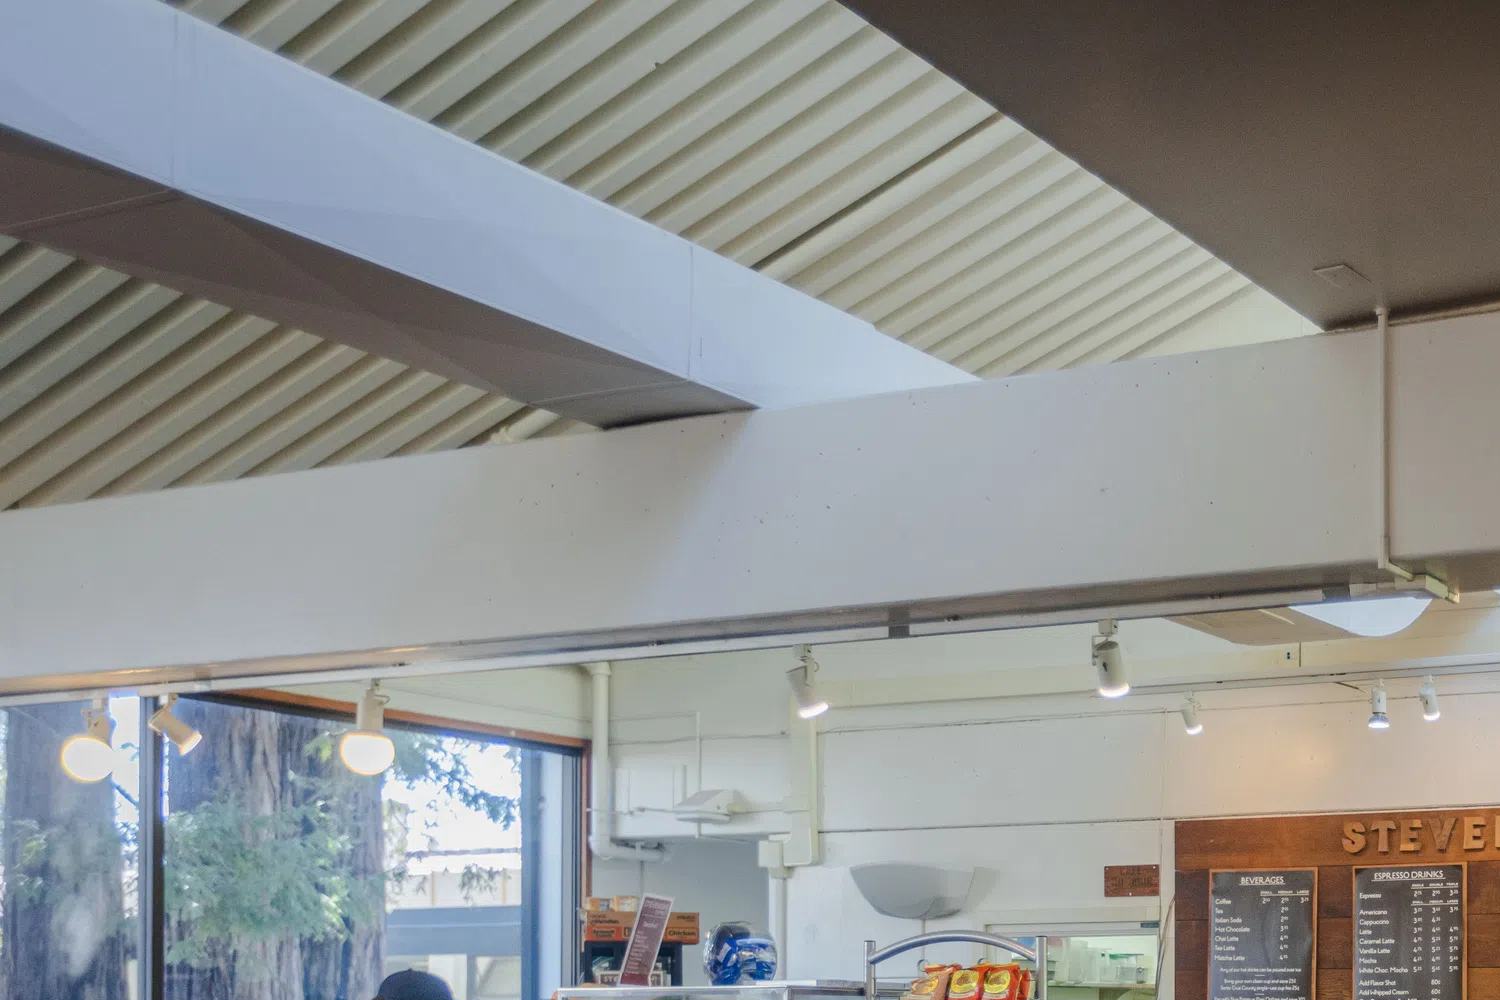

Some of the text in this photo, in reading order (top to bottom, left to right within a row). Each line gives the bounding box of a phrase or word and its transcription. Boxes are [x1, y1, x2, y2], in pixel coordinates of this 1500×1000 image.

[1374, 870, 1444, 880] ESPRESSO DRINKS
[1240, 876, 1284, 884] BEVERAGES
[1359, 892, 1382, 900] Espresso
